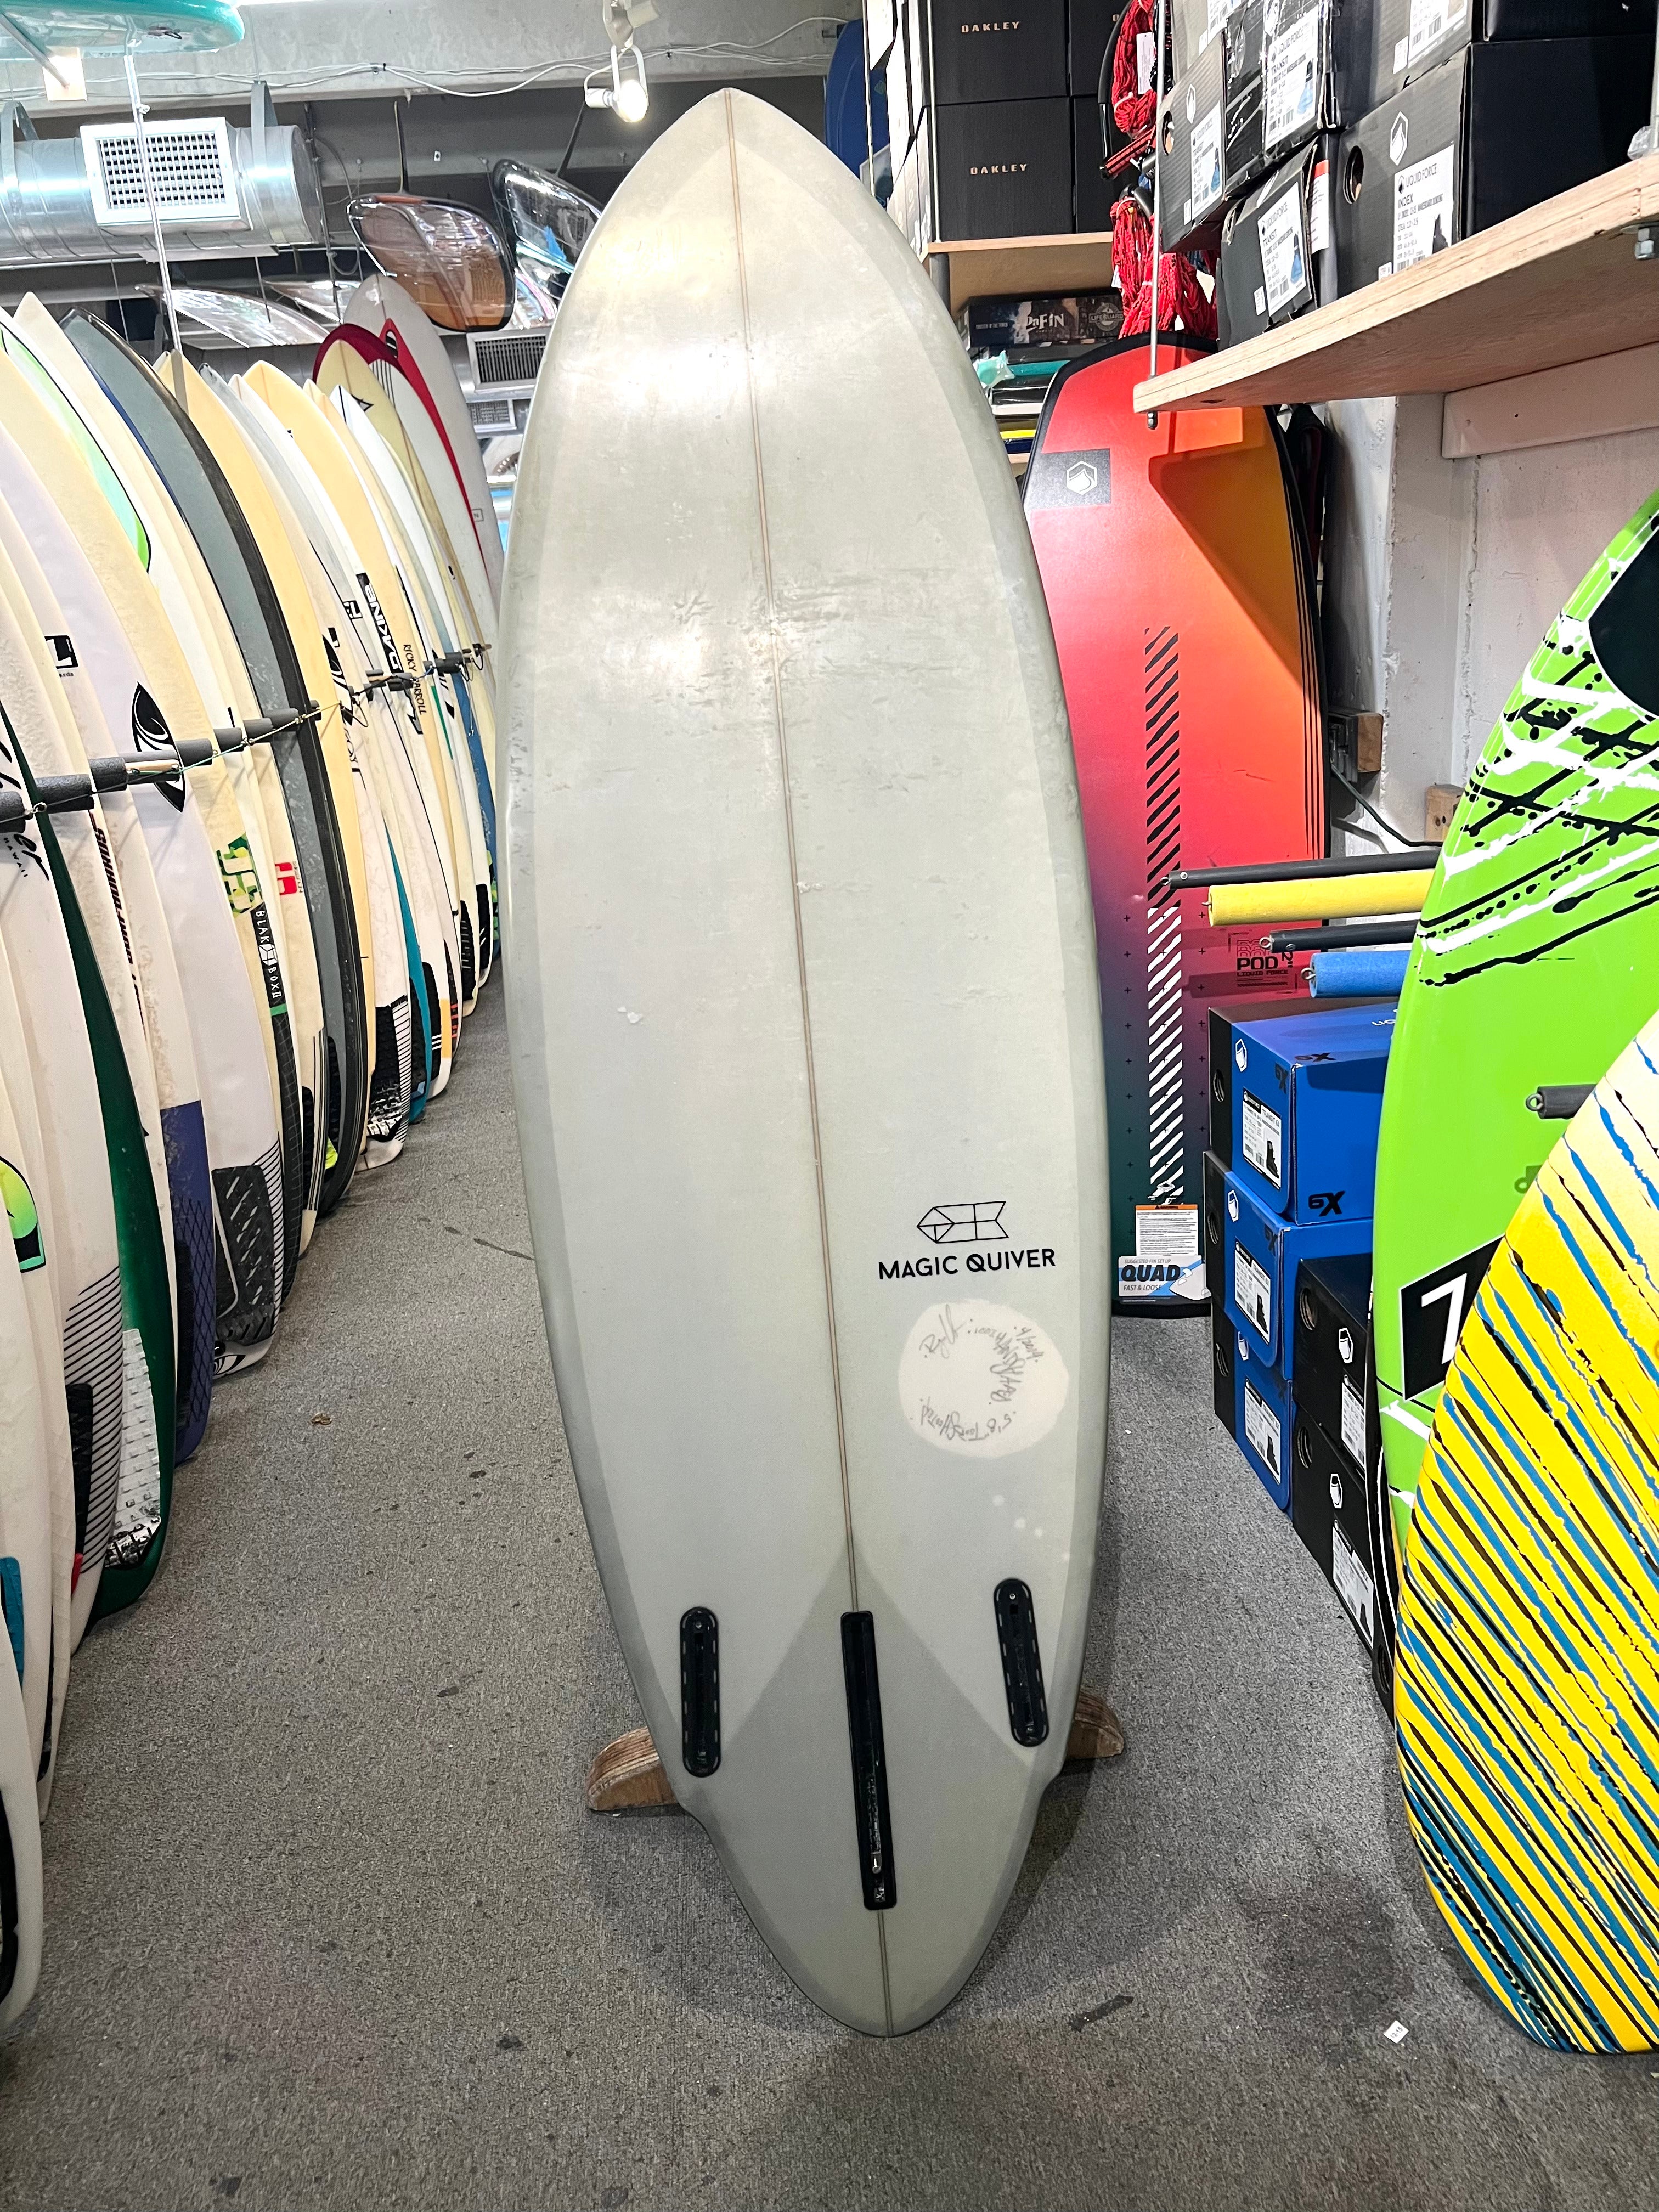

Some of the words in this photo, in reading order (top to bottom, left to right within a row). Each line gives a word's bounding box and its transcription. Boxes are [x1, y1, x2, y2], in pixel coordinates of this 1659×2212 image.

[961, 21, 1020, 33] OAKLEY
[970, 164, 1027, 175] OAKLEY
[1406, 171, 1421, 188] LIQUID
[1422, 163, 1437, 180] FORCE
[1398, 193, 1414, 208] INDEX
[1090, 311, 1124, 320] LIFEGUARD
[365, 582, 403, 672] DAKINE
[403, 644, 417, 672] RICKY
[413, 680, 427, 715] ARROLL
[3, 839, 28, 877] HAWAII
[255, 910, 270, 944] BLAK
[1237, 956, 1278, 970] POD
[1308, 1190, 1346, 1217] 6X
[878, 1255, 958, 1280] MAGIC
[966, 1248, 1056, 1272] QUIVER
[1121, 1265, 1180, 1282] QUAD
